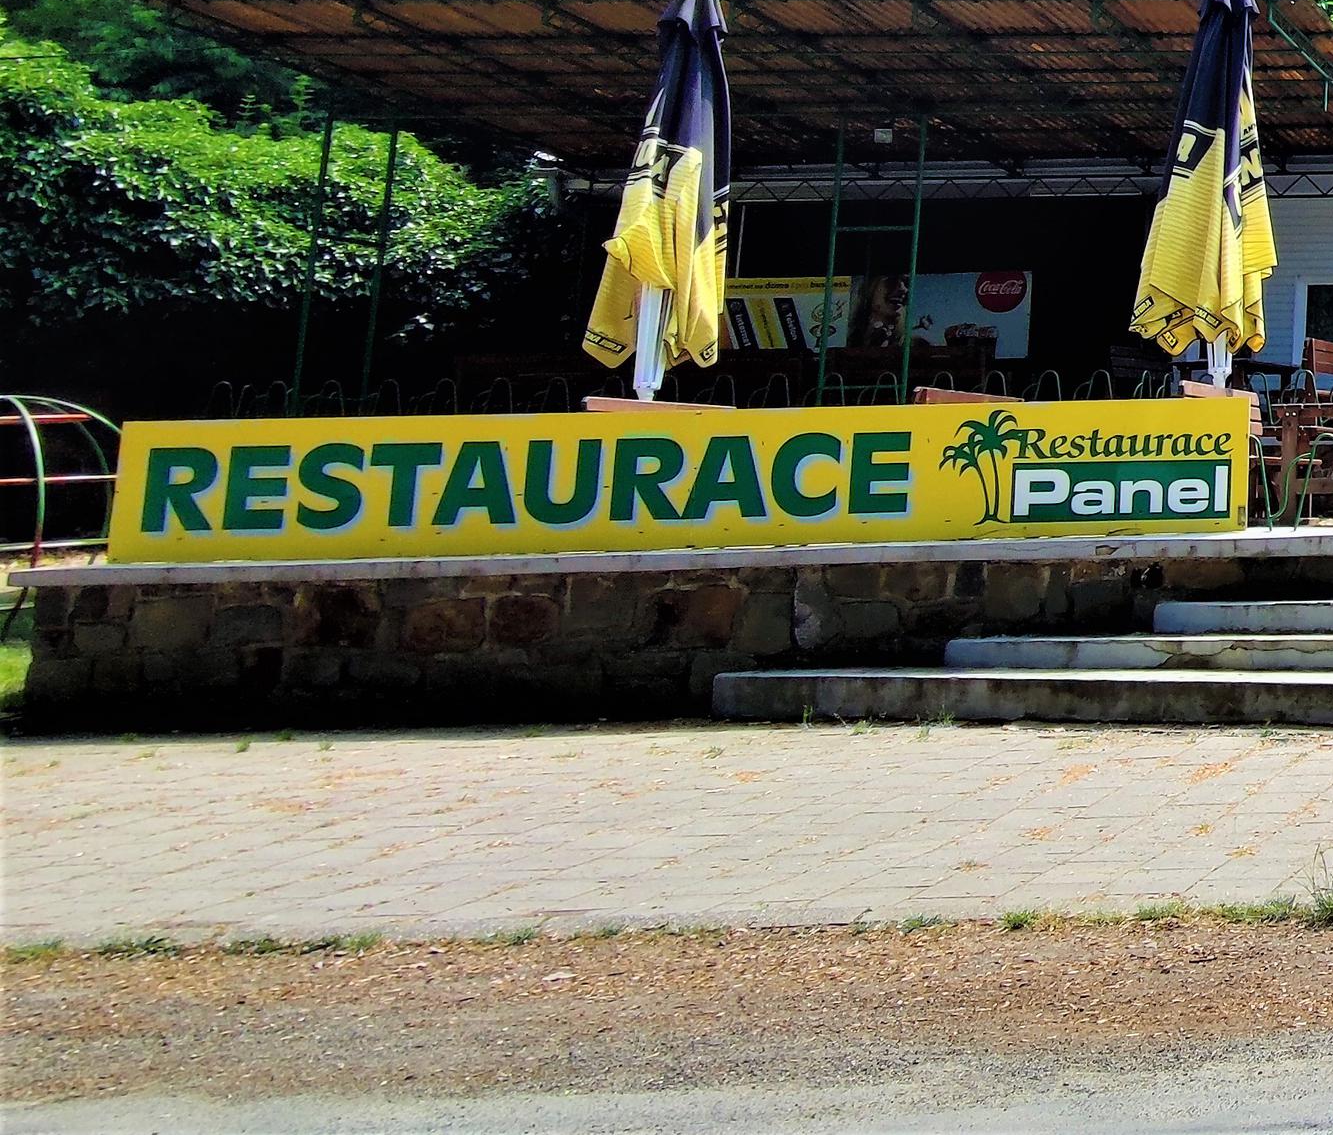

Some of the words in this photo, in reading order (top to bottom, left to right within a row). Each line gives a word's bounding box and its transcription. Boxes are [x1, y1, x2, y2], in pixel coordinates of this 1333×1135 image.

[1014, 428, 1232, 459] Restaurace
[141, 432, 912, 533] RESTAURACE
[1013, 465, 1229, 516] Panel
